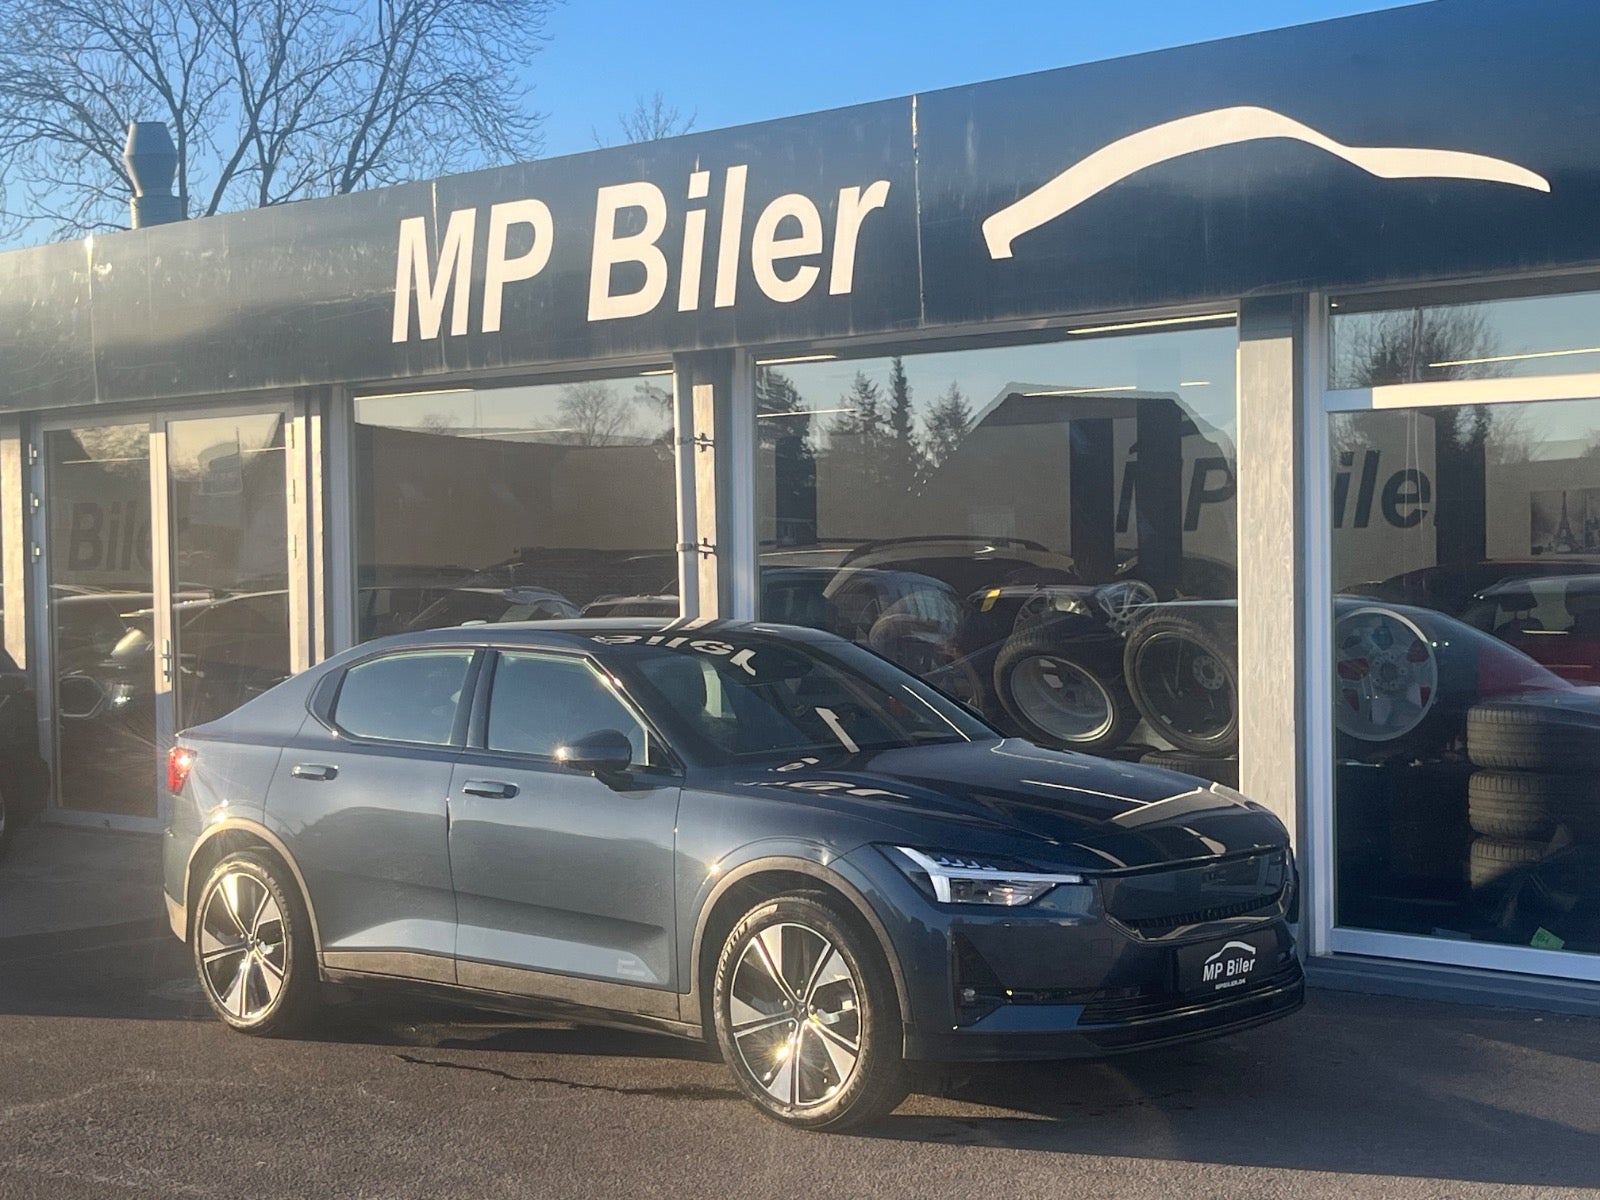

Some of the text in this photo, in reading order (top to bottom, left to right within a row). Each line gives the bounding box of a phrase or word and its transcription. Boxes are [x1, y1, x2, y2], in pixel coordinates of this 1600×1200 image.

[391, 164, 892, 343] MP Biler
[1203, 957, 1256, 982] MP Biler
